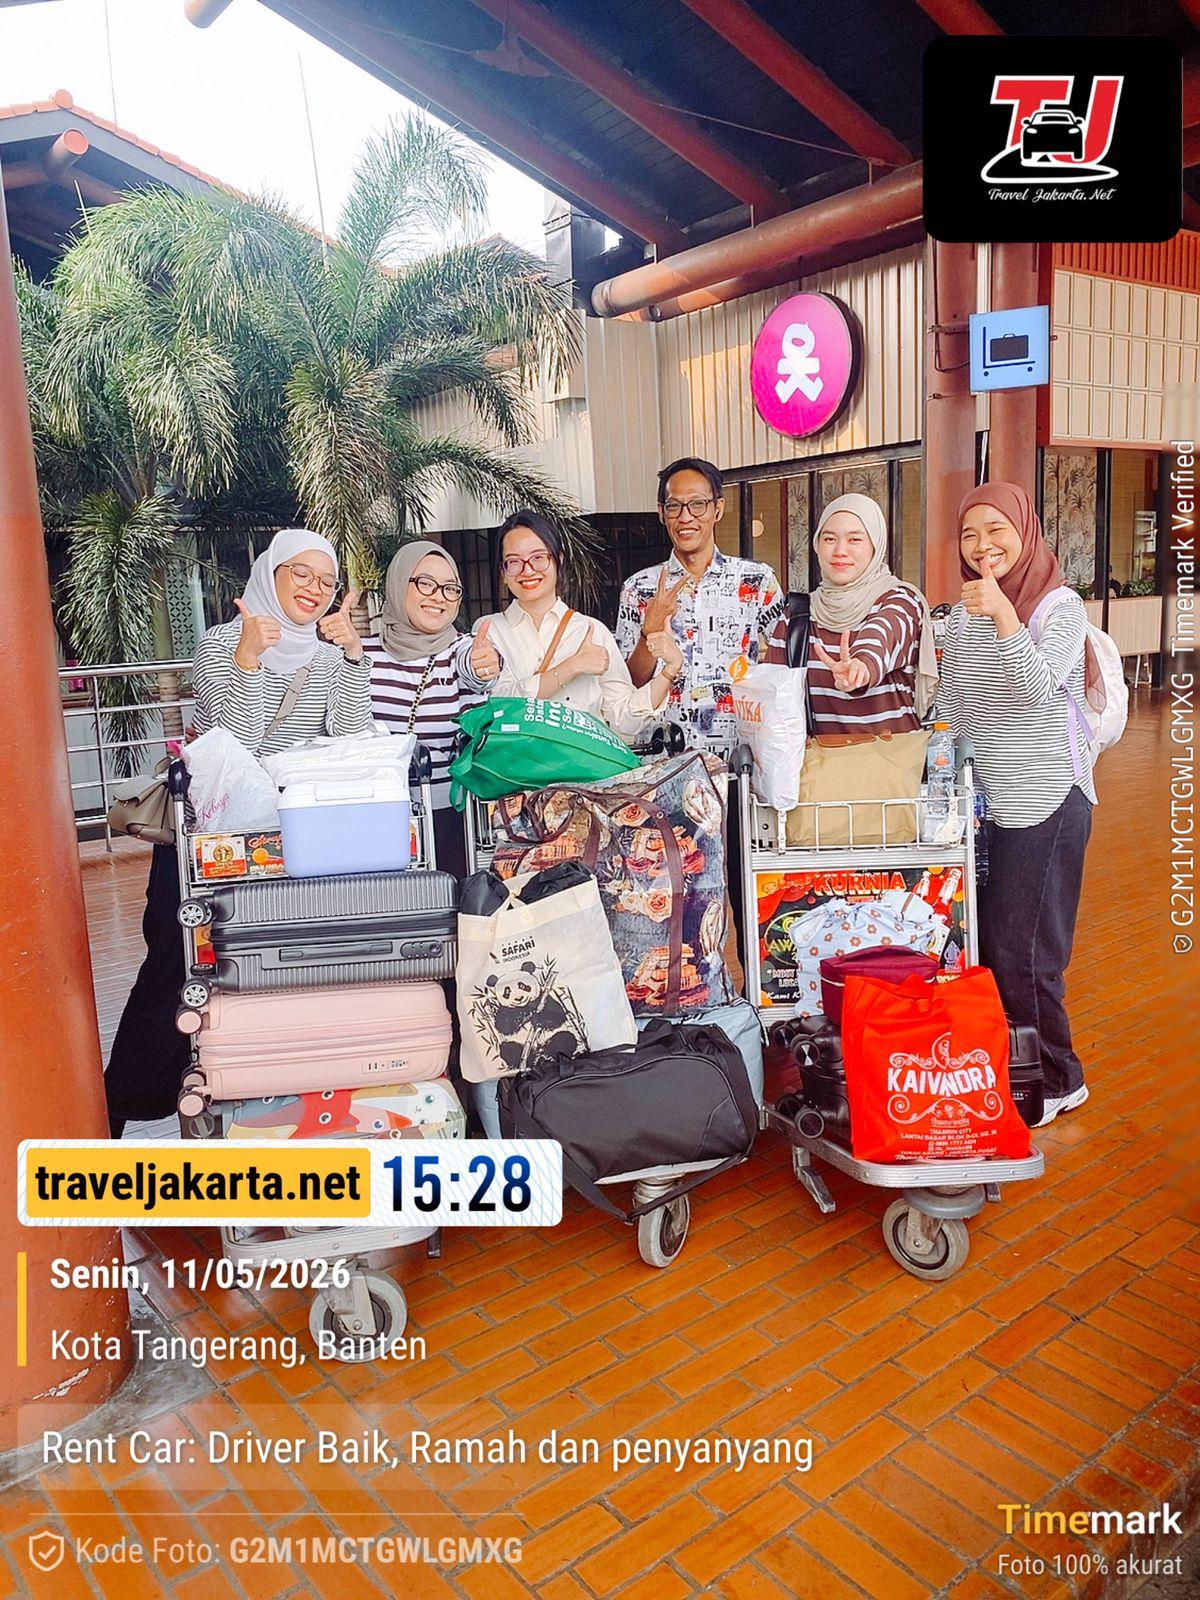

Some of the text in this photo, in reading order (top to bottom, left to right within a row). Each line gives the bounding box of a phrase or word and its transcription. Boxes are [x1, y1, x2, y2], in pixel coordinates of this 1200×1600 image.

[813, 871, 908, 897] KURNIA
[502, 939, 536, 957] SAFARI
[502, 951, 531, 963] INDONESIA
